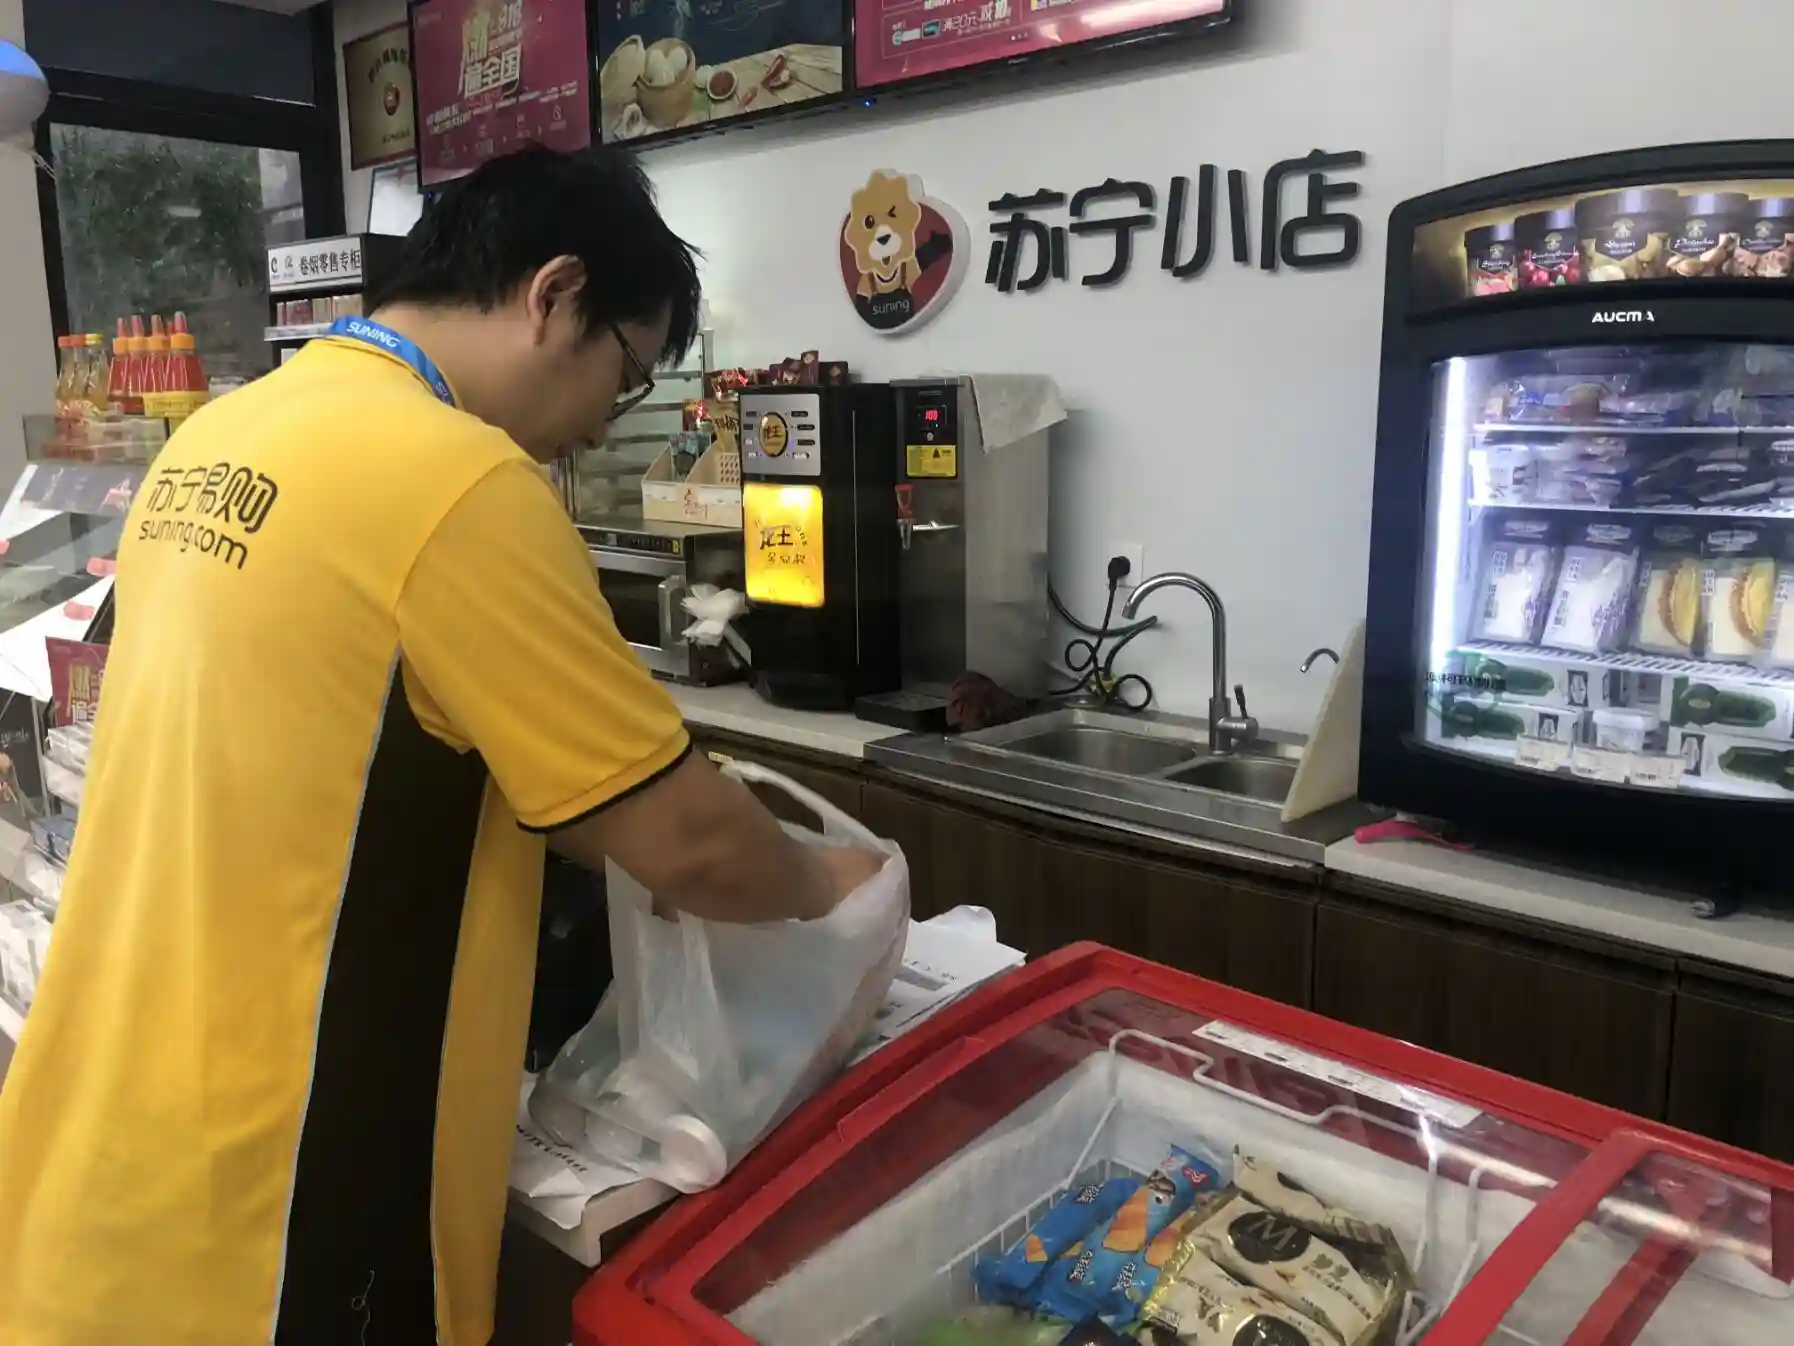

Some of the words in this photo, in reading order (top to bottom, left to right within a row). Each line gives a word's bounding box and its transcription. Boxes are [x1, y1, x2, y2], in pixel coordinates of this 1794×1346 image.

[984, 149, 1363, 292] 苏宁小店
[300, 249, 361, 276] 卷烟零售专柜
[872, 299, 910, 316] suning
[1591, 310, 1655, 323] AUCMA
[346, 320, 400, 348] SUNING
[146, 461, 278, 534] 苏宁易购
